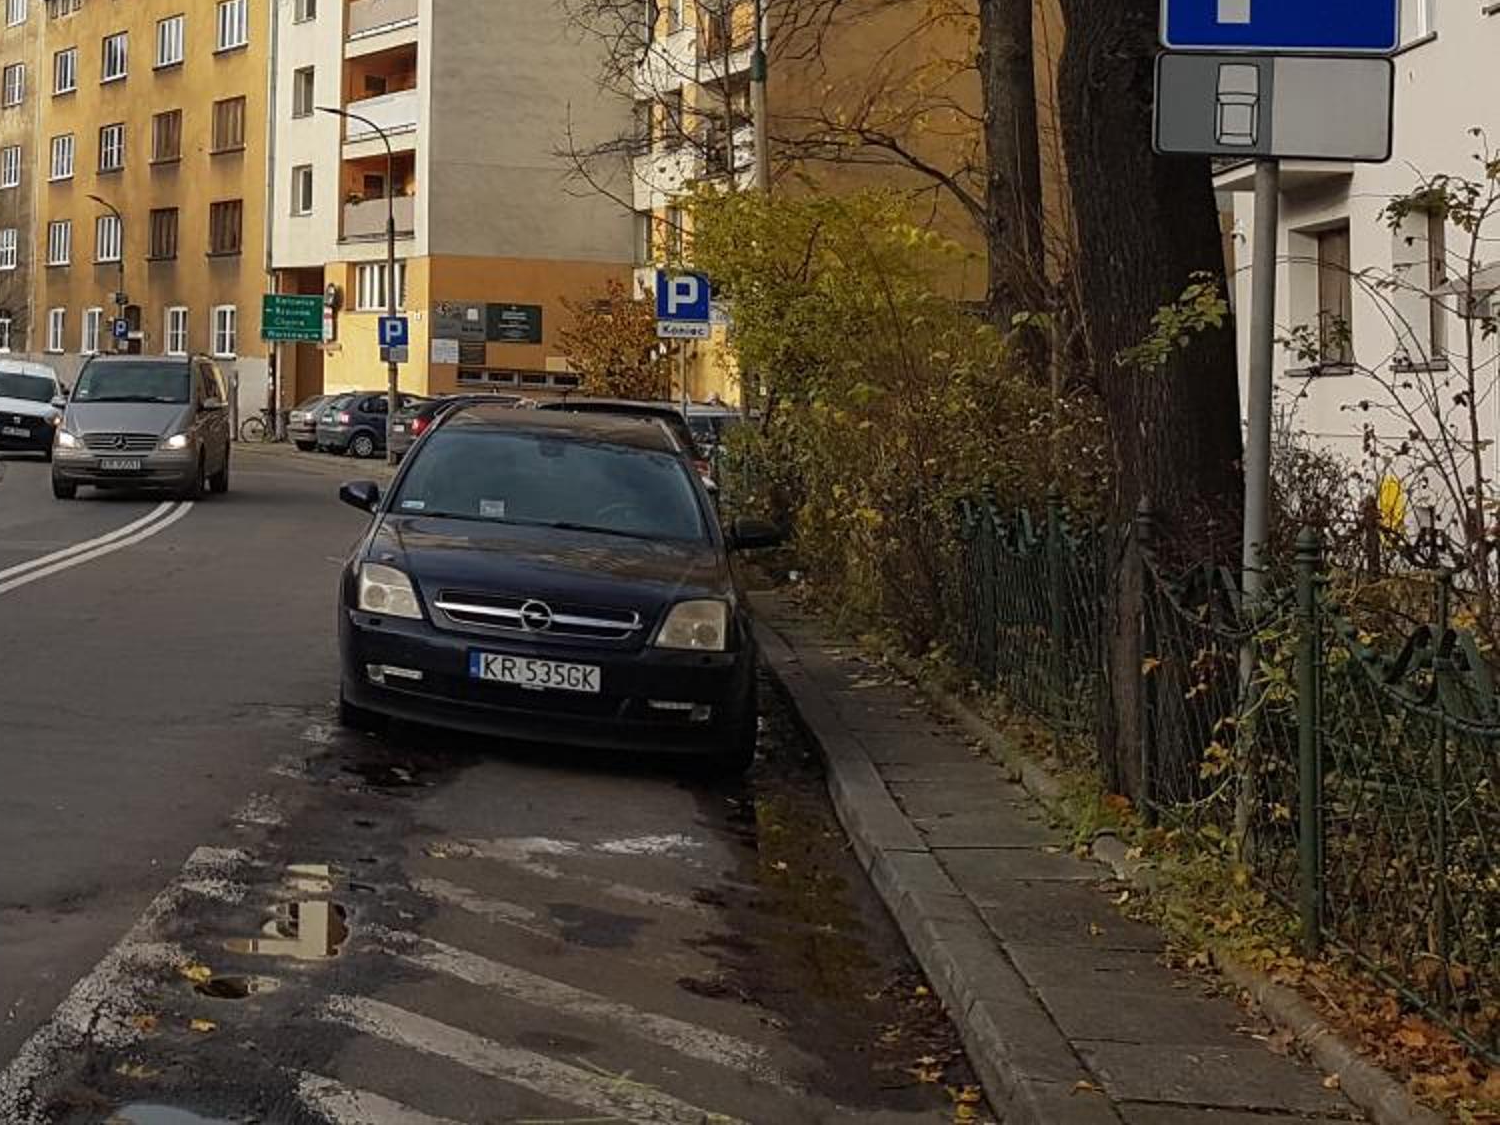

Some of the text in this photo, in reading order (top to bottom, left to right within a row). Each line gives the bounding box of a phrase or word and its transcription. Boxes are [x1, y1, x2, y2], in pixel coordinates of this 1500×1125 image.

[667, 276, 698, 314] P
[115, 320, 127, 336] P
[385, 320, 403, 344] P
[484, 654, 596, 690] KR 535GK
